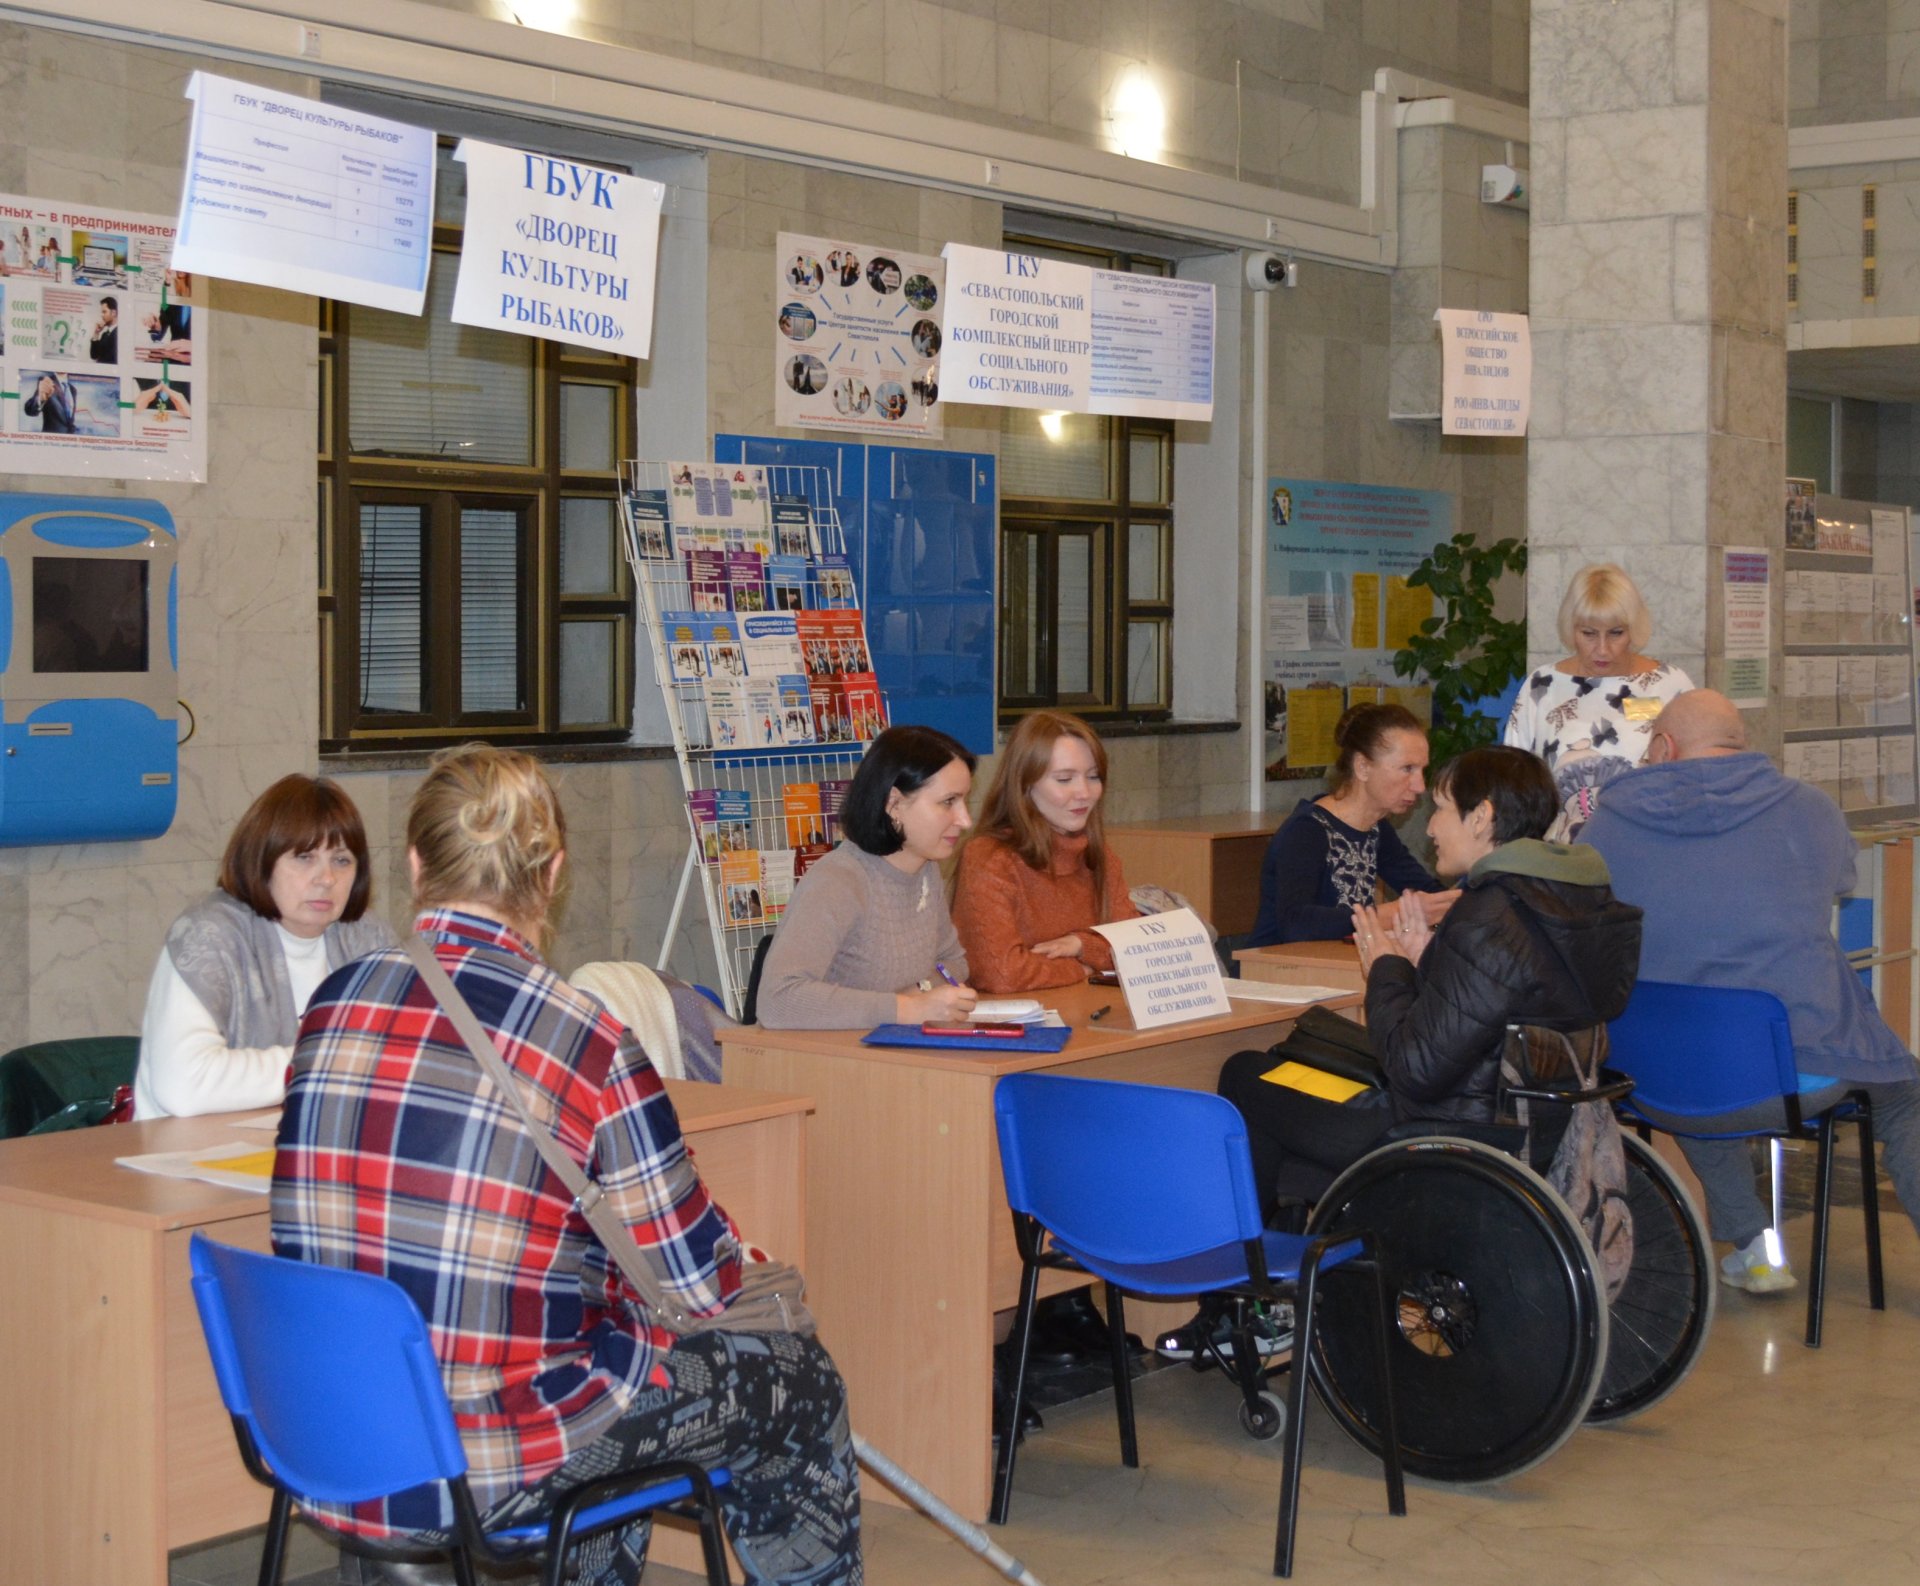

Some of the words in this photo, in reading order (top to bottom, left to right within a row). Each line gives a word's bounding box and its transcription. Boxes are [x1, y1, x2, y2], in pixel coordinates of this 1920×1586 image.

[233, 94, 257, 109] ГБУК
[261, 101, 303, 121] "ДВОРЕЦ
[305, 112, 353, 133] КУЛЬТУРЫ
[354, 125, 404, 144] РЫБАКОВ"
[523, 154, 618, 210] ГБУК
[50, 212, 58, 223] в
[515, 214, 618, 261] «ДВОРЕЦ
[501, 250, 629, 301] КУЛЬТУРЫ
[1005, 253, 1042, 279] ГКУ
[961, 281, 1085, 311] «СЕВАСТОПОЛЬСКИЙ
[500, 293, 624, 340] РЫБАКОВ»
[990, 307, 1060, 330] ГОРОДСКОЙ
[952, 327, 1050, 350] КОМПЛЕКСНЫЙ
[1053, 339, 1090, 355] ЦЕНТР
[979, 352, 1068, 375] СОЦИАЛЬНОГО
[968, 375, 1074, 398] ОБСЛУЖИВАНИЯ»
[1138, 921, 1166, 936] ГКУ
[1124, 932, 1206, 956] «СЕВАСТОПОЛЬСКИЙ
[1146, 952, 1192, 969] ГОРОДСКОЙ
[1128, 967, 1191, 987] КОМПЛЕКСНЫЙ
[1192, 963, 1216, 976] ЦЕНТР
[1148, 980, 1207, 999] СОЦИАЛЬНОГО
